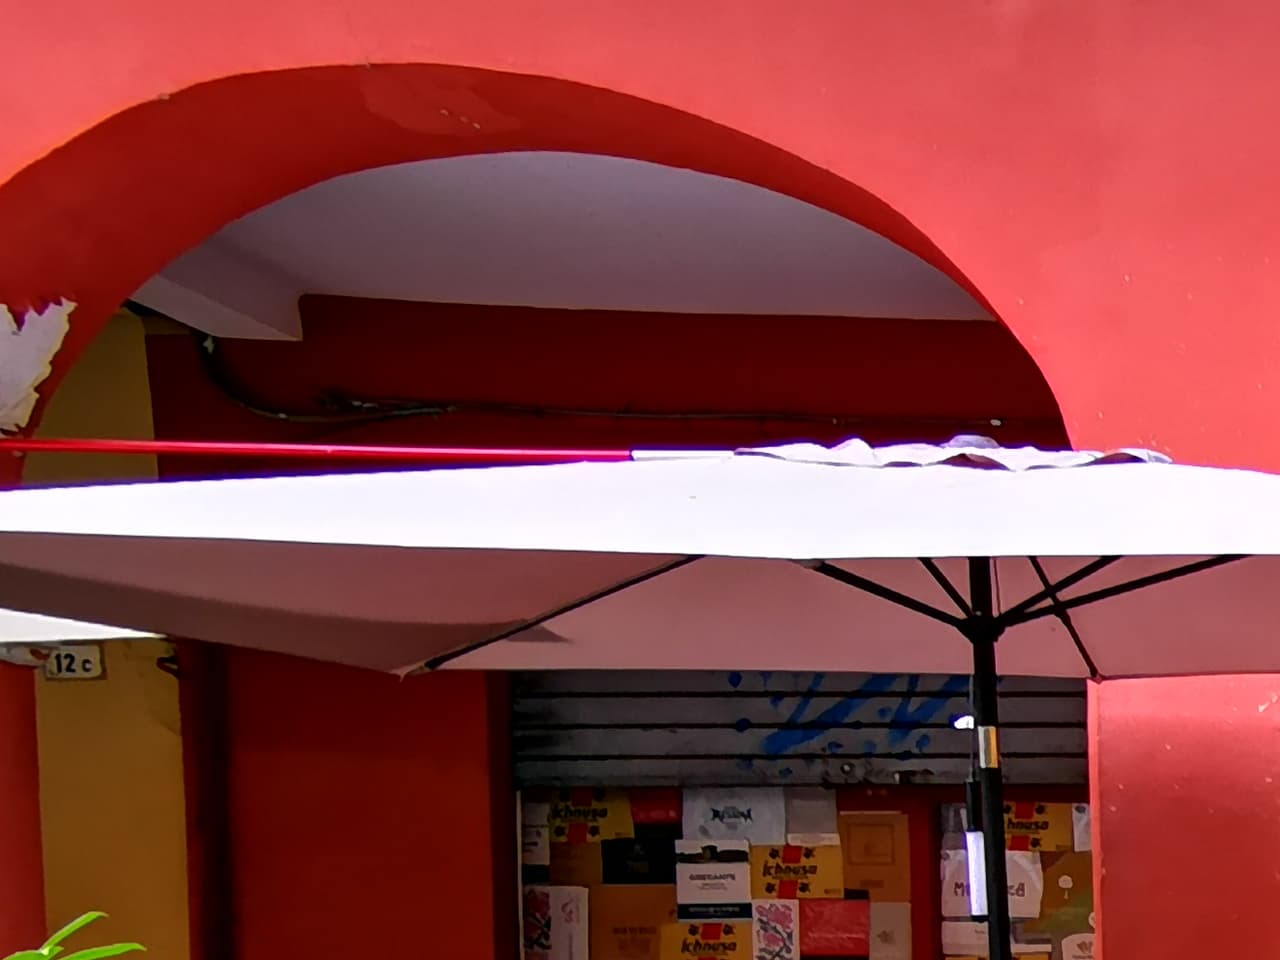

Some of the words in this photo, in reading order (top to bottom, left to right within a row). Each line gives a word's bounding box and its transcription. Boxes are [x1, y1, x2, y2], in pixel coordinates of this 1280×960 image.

[55, 653, 76, 673] 12
[762, 860, 818, 877] Ichnusa
[681, 937, 738, 954] Ichnusa
